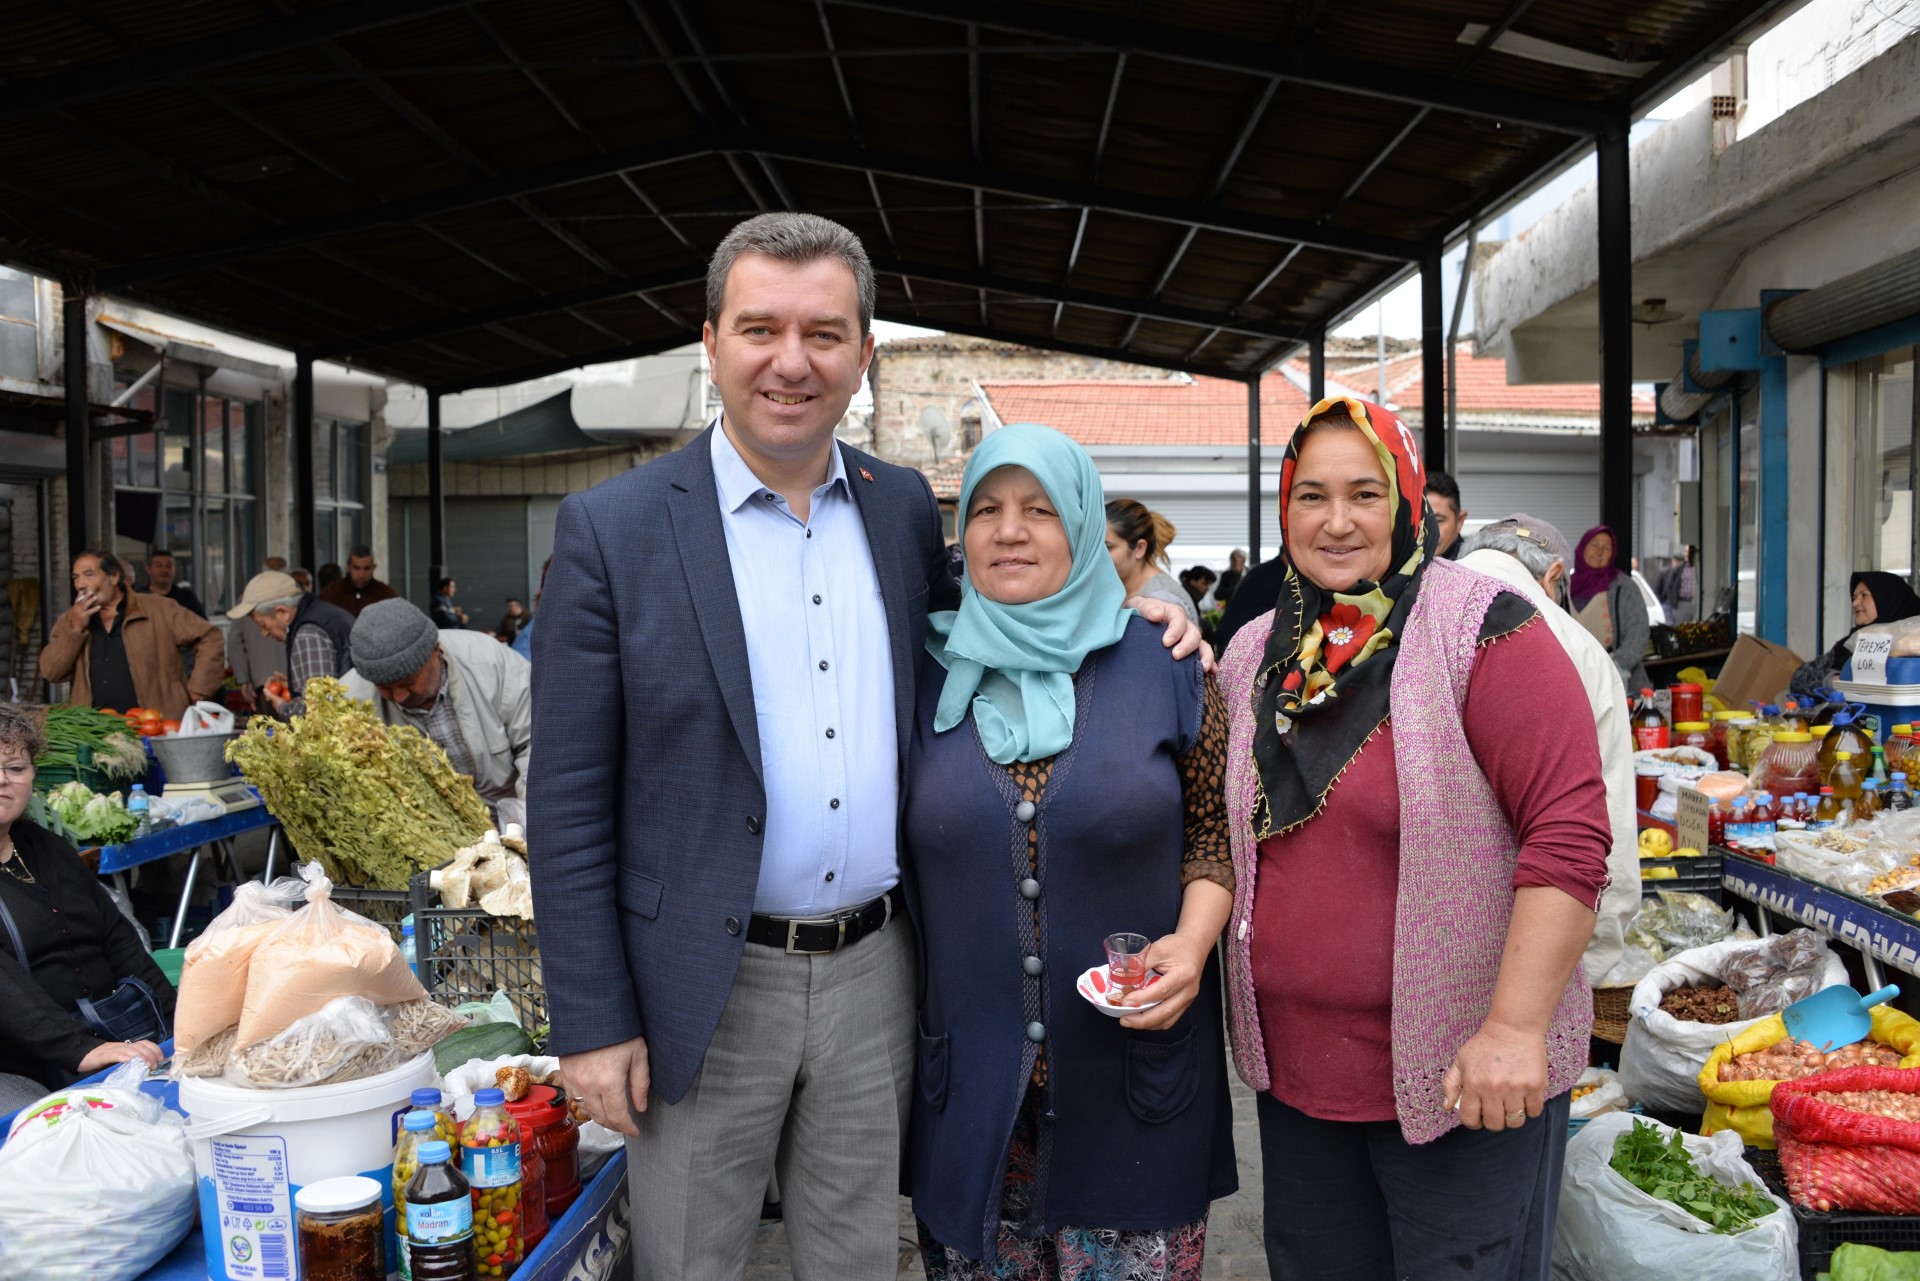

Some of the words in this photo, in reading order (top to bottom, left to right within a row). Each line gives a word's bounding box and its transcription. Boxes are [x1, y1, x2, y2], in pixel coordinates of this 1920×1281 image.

[1857, 659, 1875, 670] LOR
[1680, 815, 1705, 834] DOĞAL
[417, 1219, 449, 1229] Madran
